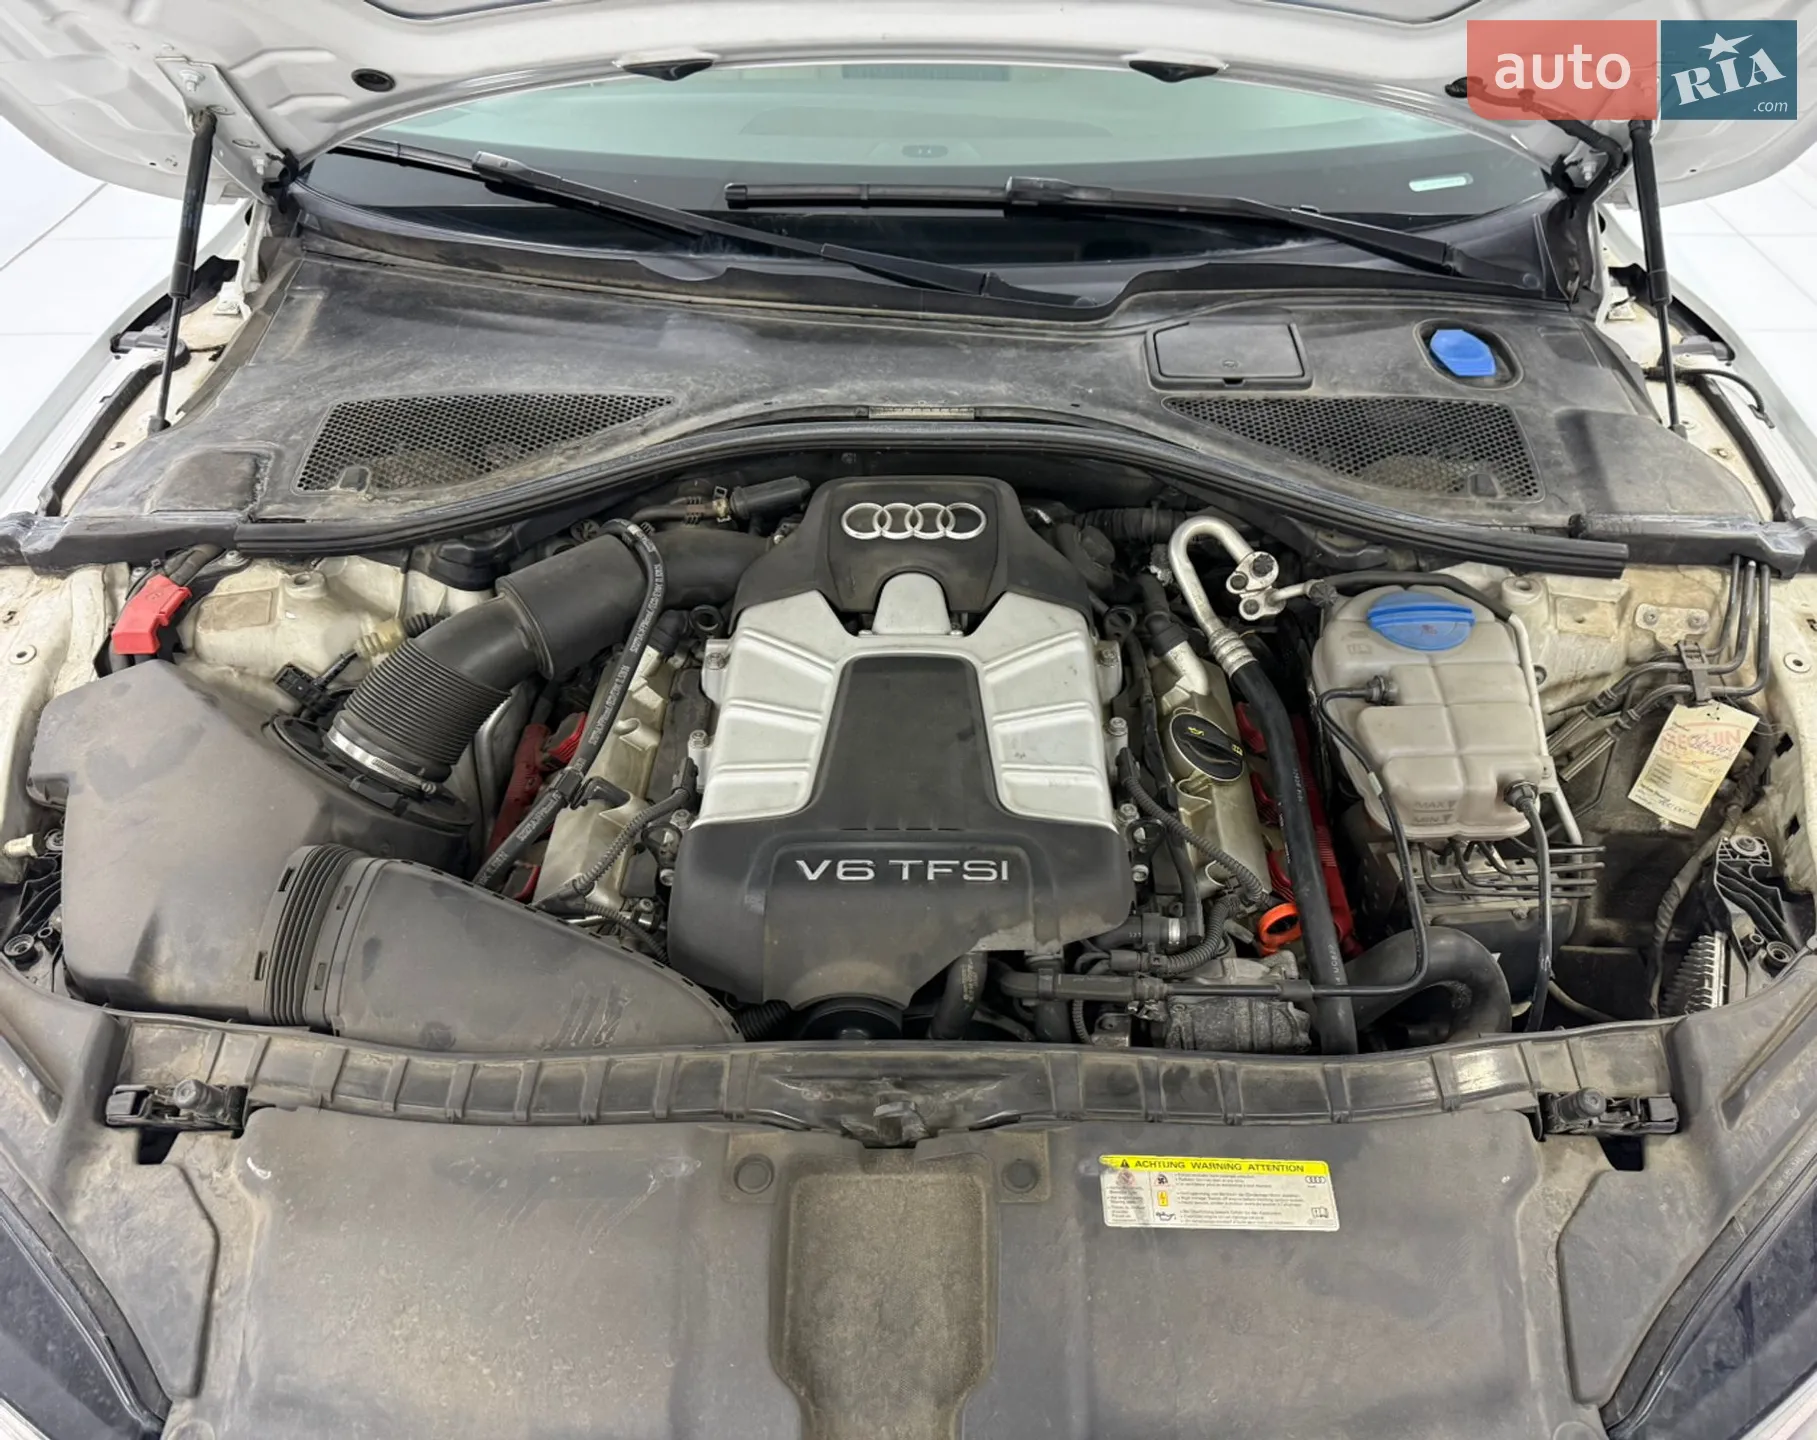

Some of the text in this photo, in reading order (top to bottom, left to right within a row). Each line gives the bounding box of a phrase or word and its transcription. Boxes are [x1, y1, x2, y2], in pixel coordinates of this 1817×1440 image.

[795, 859, 1009, 881] V6 TFSI
[1134, 1160, 1305, 1173] ACHTUNG WARNING ATTENTION
